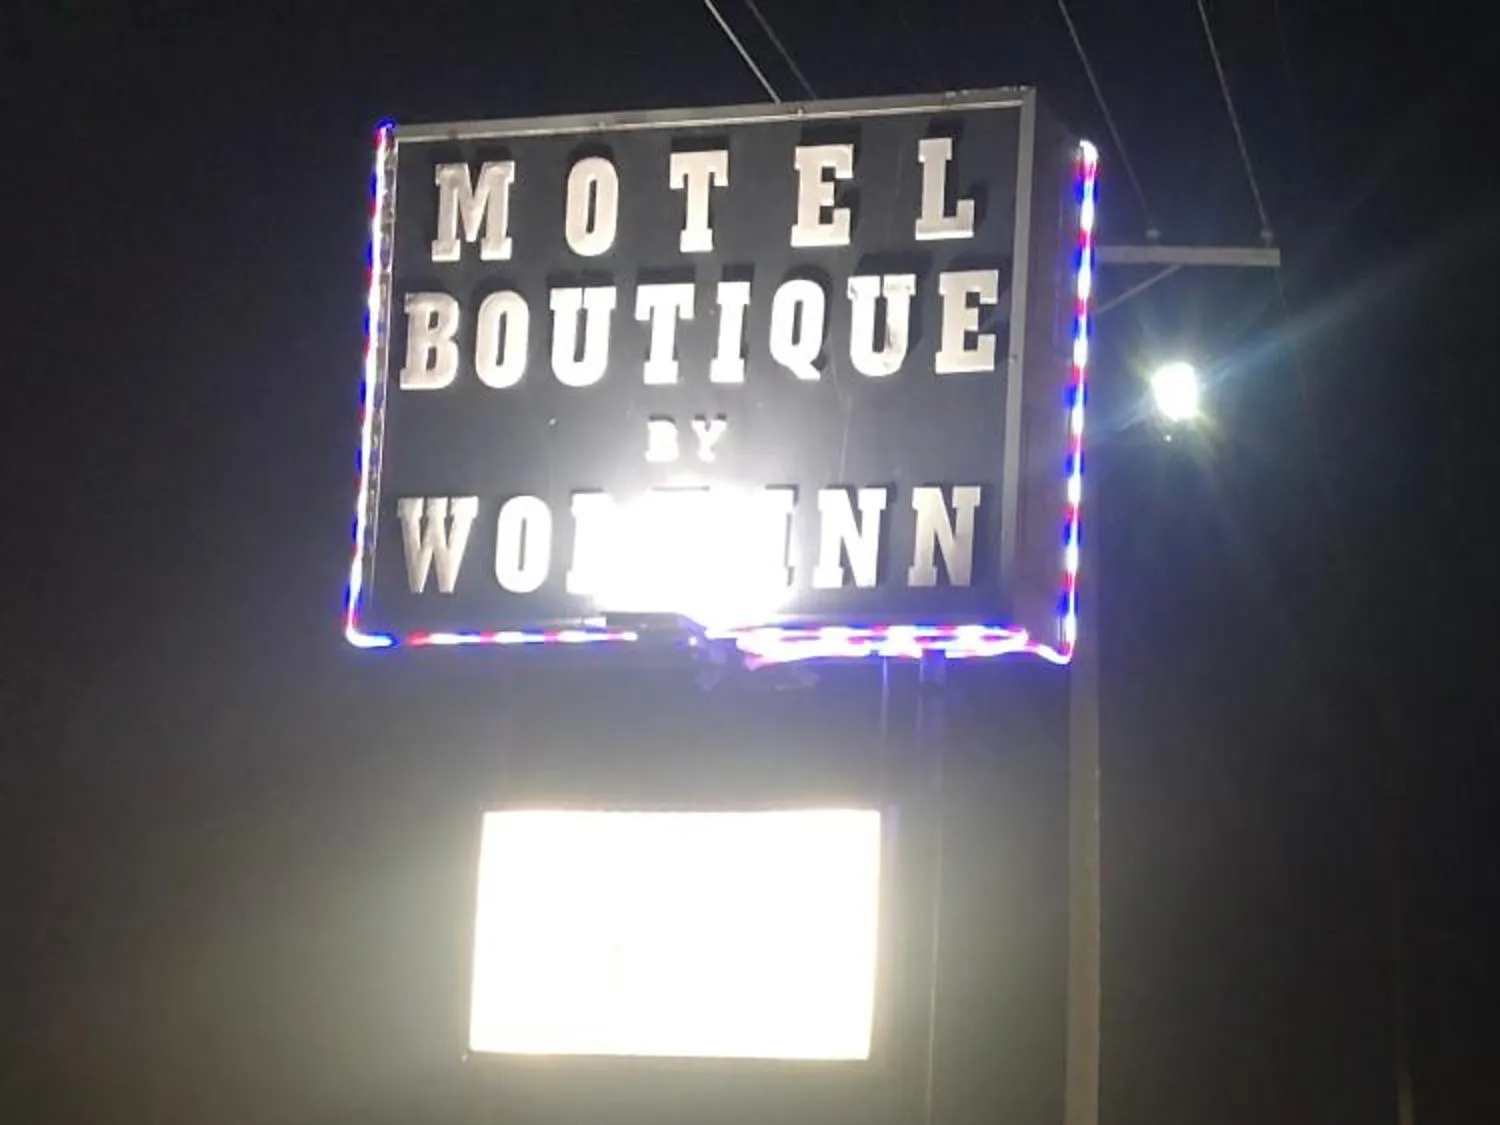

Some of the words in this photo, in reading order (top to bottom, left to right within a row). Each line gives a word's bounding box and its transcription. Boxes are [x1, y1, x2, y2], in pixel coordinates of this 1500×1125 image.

[430, 136, 975, 262] MOTEL
[399, 269, 999, 390] BOUTIQUE
[645, 416, 728, 462] BY
